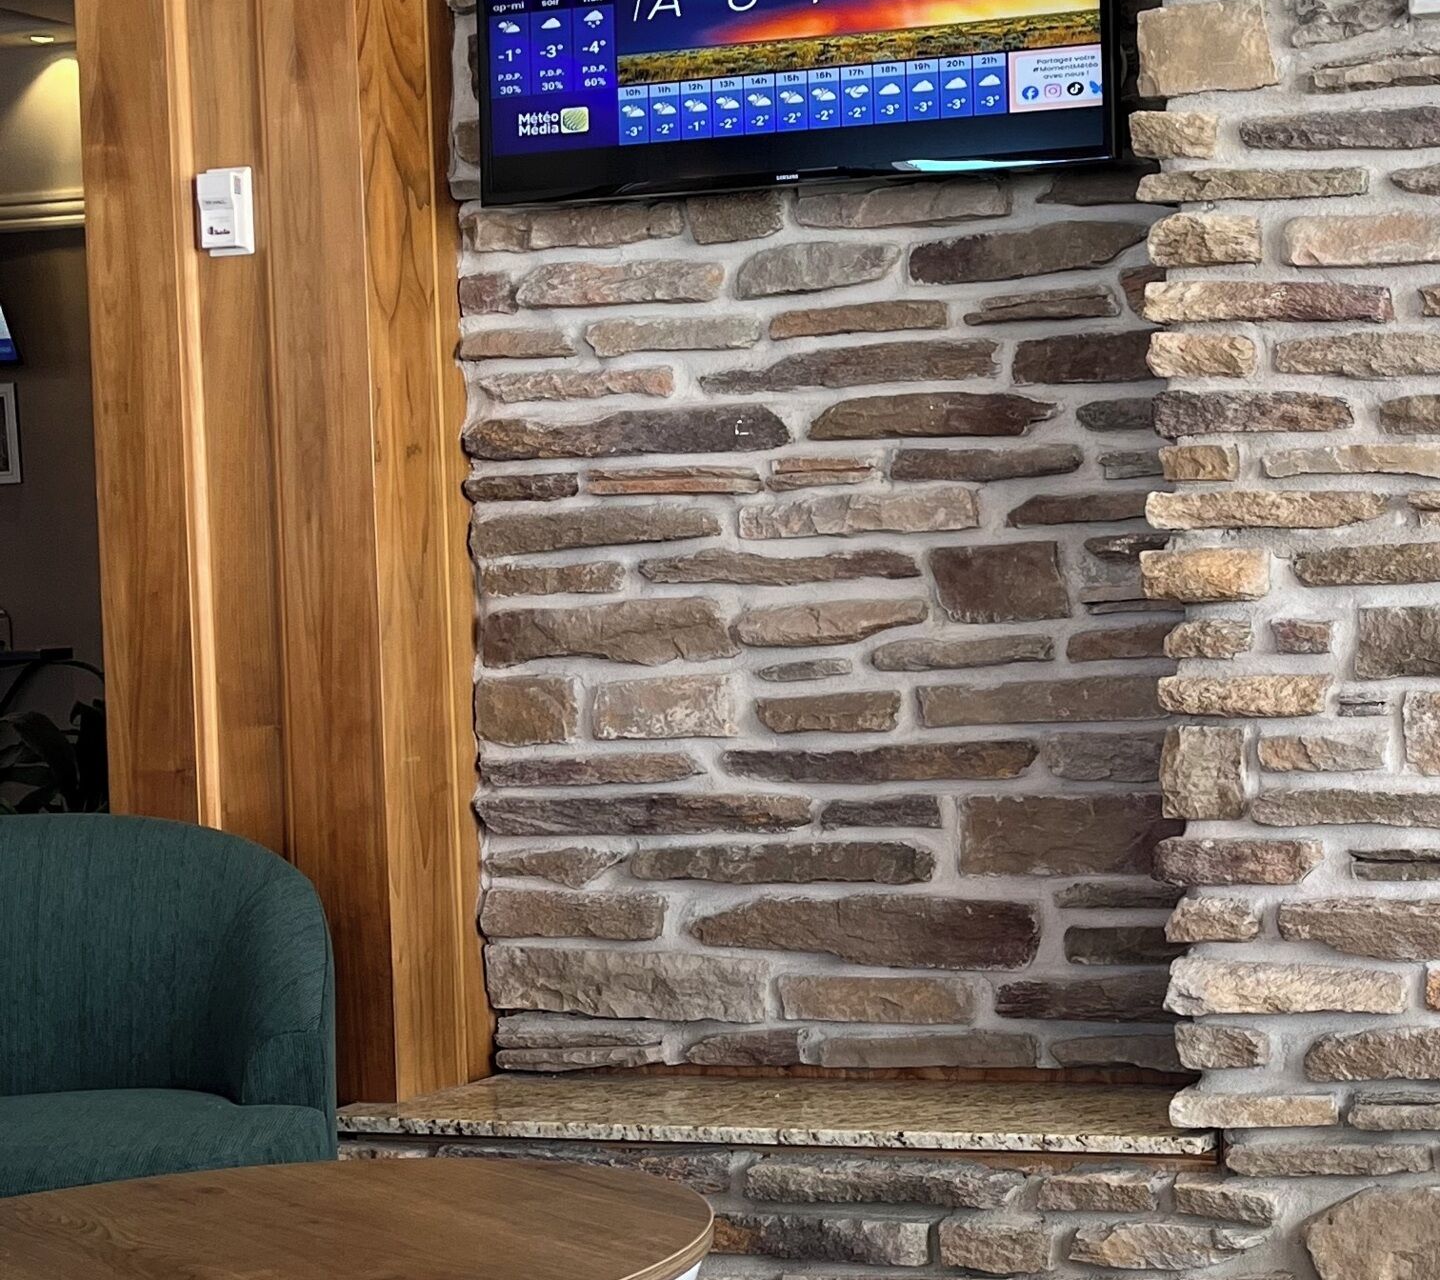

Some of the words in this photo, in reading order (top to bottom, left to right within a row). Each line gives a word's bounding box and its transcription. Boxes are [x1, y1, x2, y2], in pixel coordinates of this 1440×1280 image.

[946, 59, 965, 68] 20h
[981, 56, 997, 64] 21h
[849, 68, 864, 76] 17h
[584, 77, 606, 87] 60%
[719, 80, 735, 88] 13h
[751, 77, 767, 85] 14h
[541, 81, 563, 91] 30%
[658, 86, 671, 94] 11h
[688, 83, 703, 91] 12h
[500, 86, 521, 95] 30%
[518, 111, 559, 125] Météo
[518, 123, 559, 136] Média
